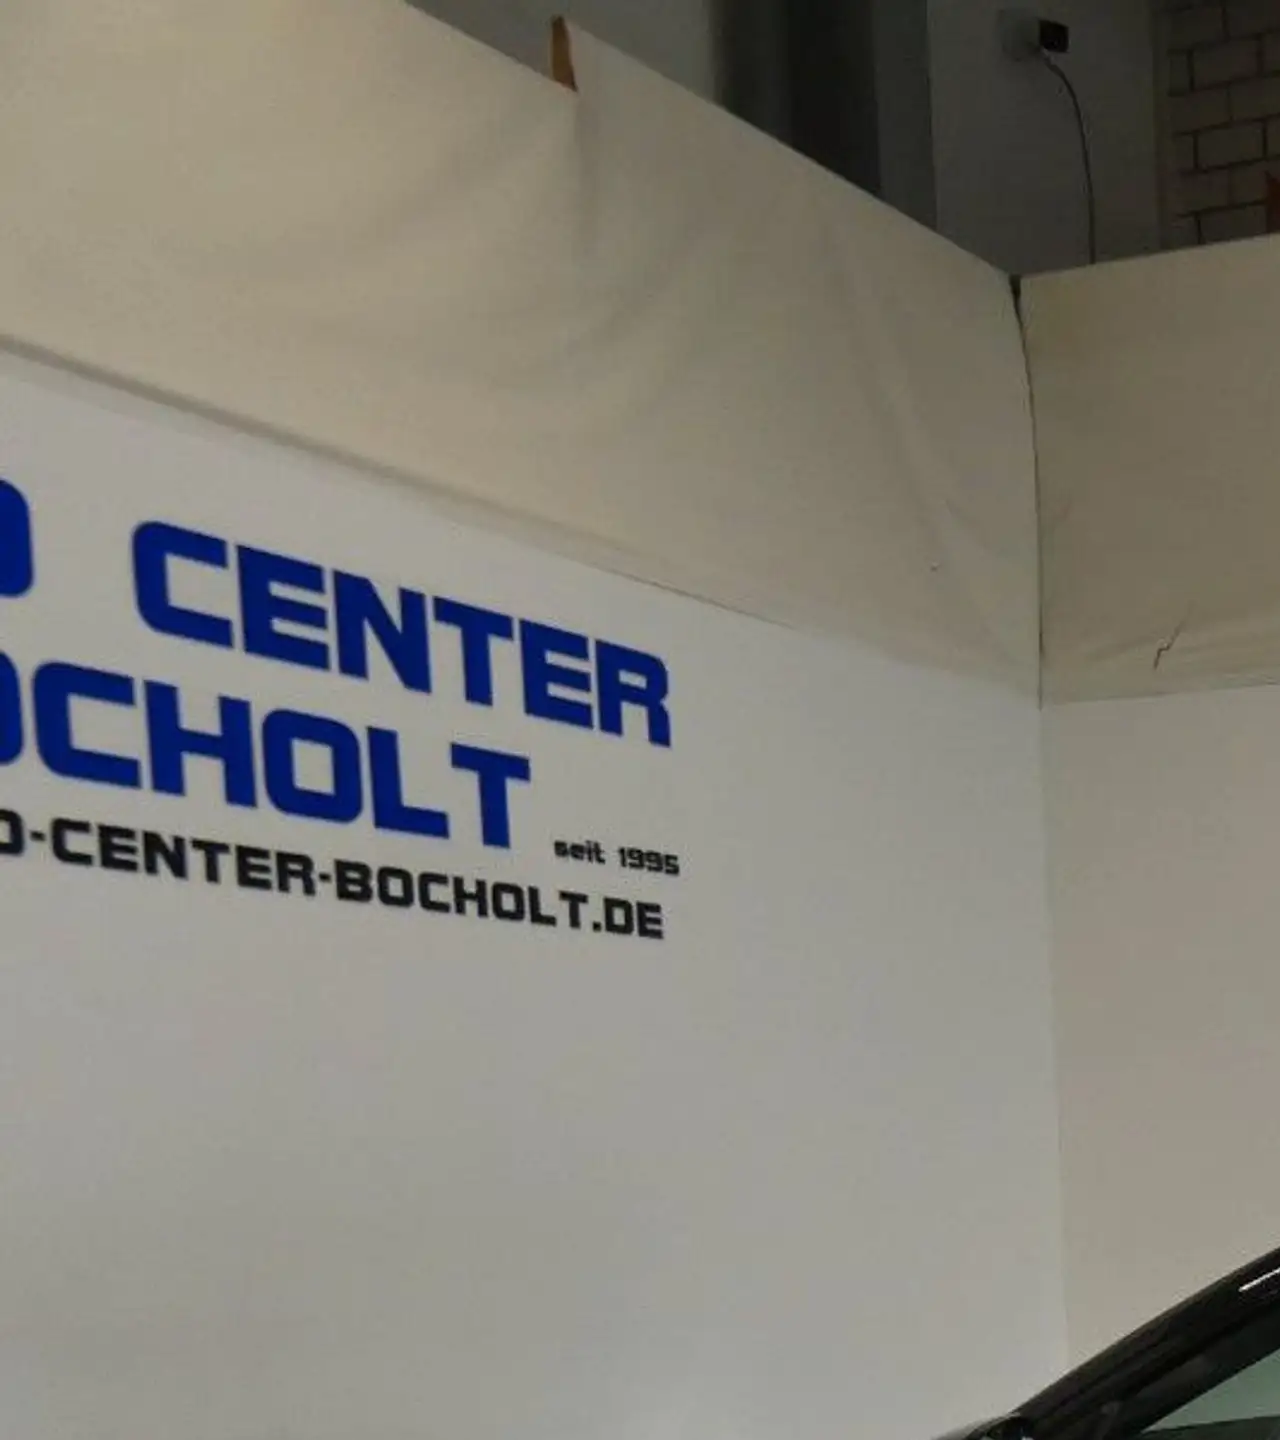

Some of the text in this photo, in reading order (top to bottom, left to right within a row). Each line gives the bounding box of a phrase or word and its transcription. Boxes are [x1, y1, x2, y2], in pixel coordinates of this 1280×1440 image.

[132, 520, 672, 748] CENTER
[0, 652, 681, 876] CHOLT seit 1995
